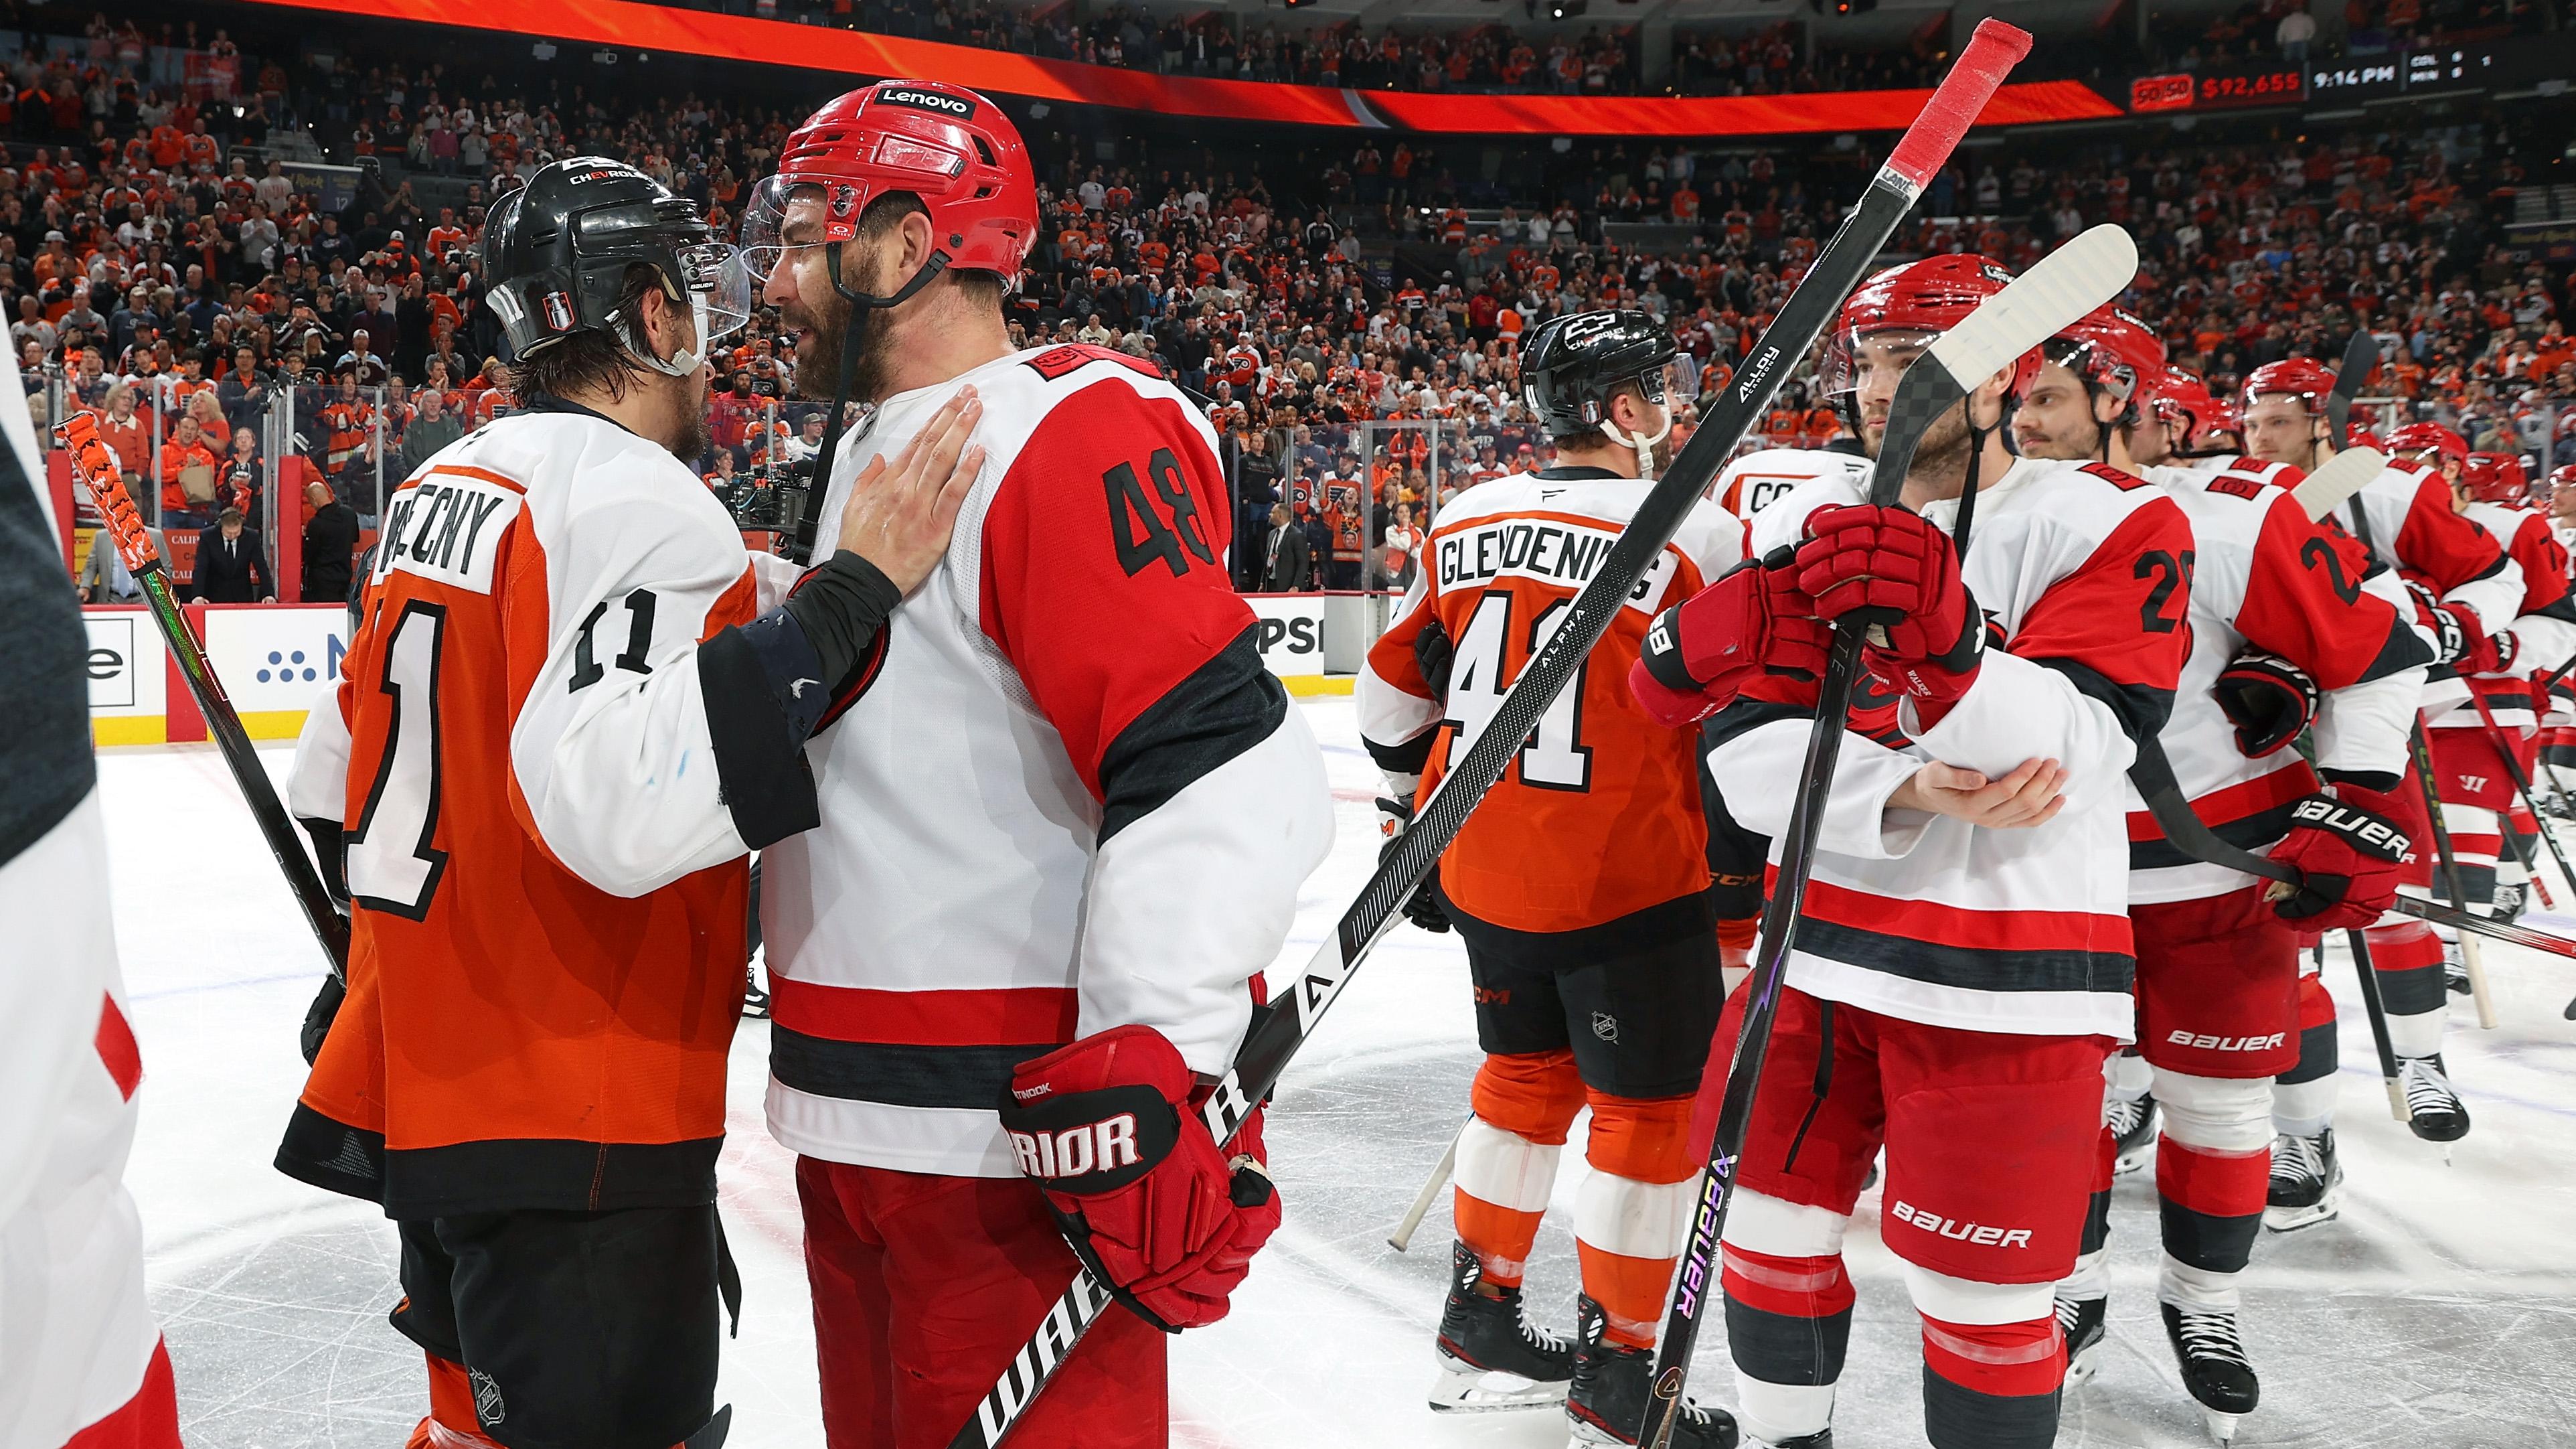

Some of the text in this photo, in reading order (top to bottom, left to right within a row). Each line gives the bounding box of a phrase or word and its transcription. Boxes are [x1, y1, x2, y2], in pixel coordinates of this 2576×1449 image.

[2361, 65, 2395, 84] PM
[883, 89, 967, 113] Lenovo
[570, 170, 645, 185] CHEVROL
[1740, 346, 1781, 404] ALLOY
[1748, 361, 1774, 394] CARBON
[1103, 447, 1216, 579] 48
[568, 588, 657, 694] 11
[1542, 607, 1585, 669] ALPHA
[1441, 591, 1593, 793] 41
[1908, 670, 1932, 696] WALKER
[2291, 800, 2411, 859] BAUER
[1598, 1020, 1613, 1033] NHL
[2167, 1030, 2285, 1051] BAUER
[1891, 1201, 2032, 1249] BAUER
[1676, 1176, 1724, 1320] BAUER
[482, 1388, 496, 1409] NHL
